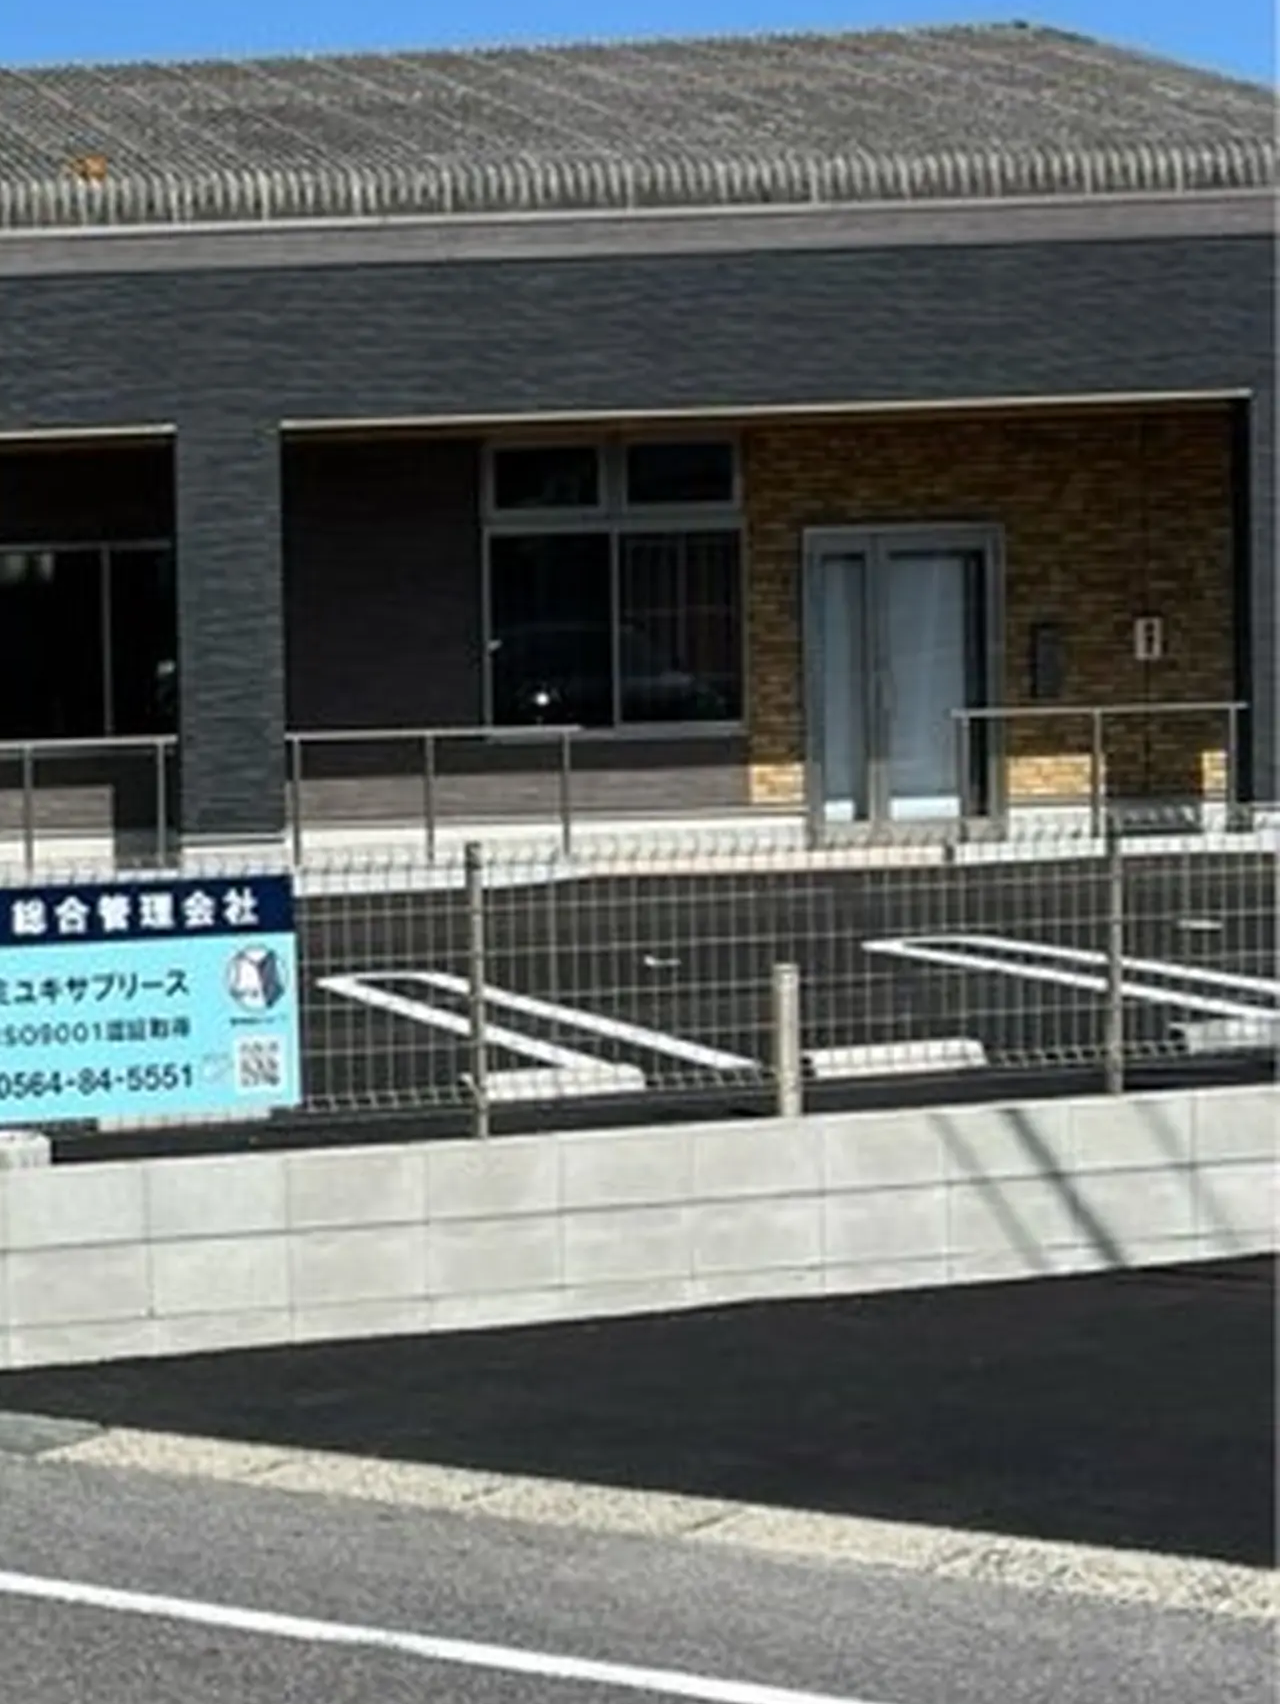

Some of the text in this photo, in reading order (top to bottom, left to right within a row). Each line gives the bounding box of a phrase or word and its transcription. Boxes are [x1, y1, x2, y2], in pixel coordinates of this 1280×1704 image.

[10, 887, 260, 936] 総合管理会社
